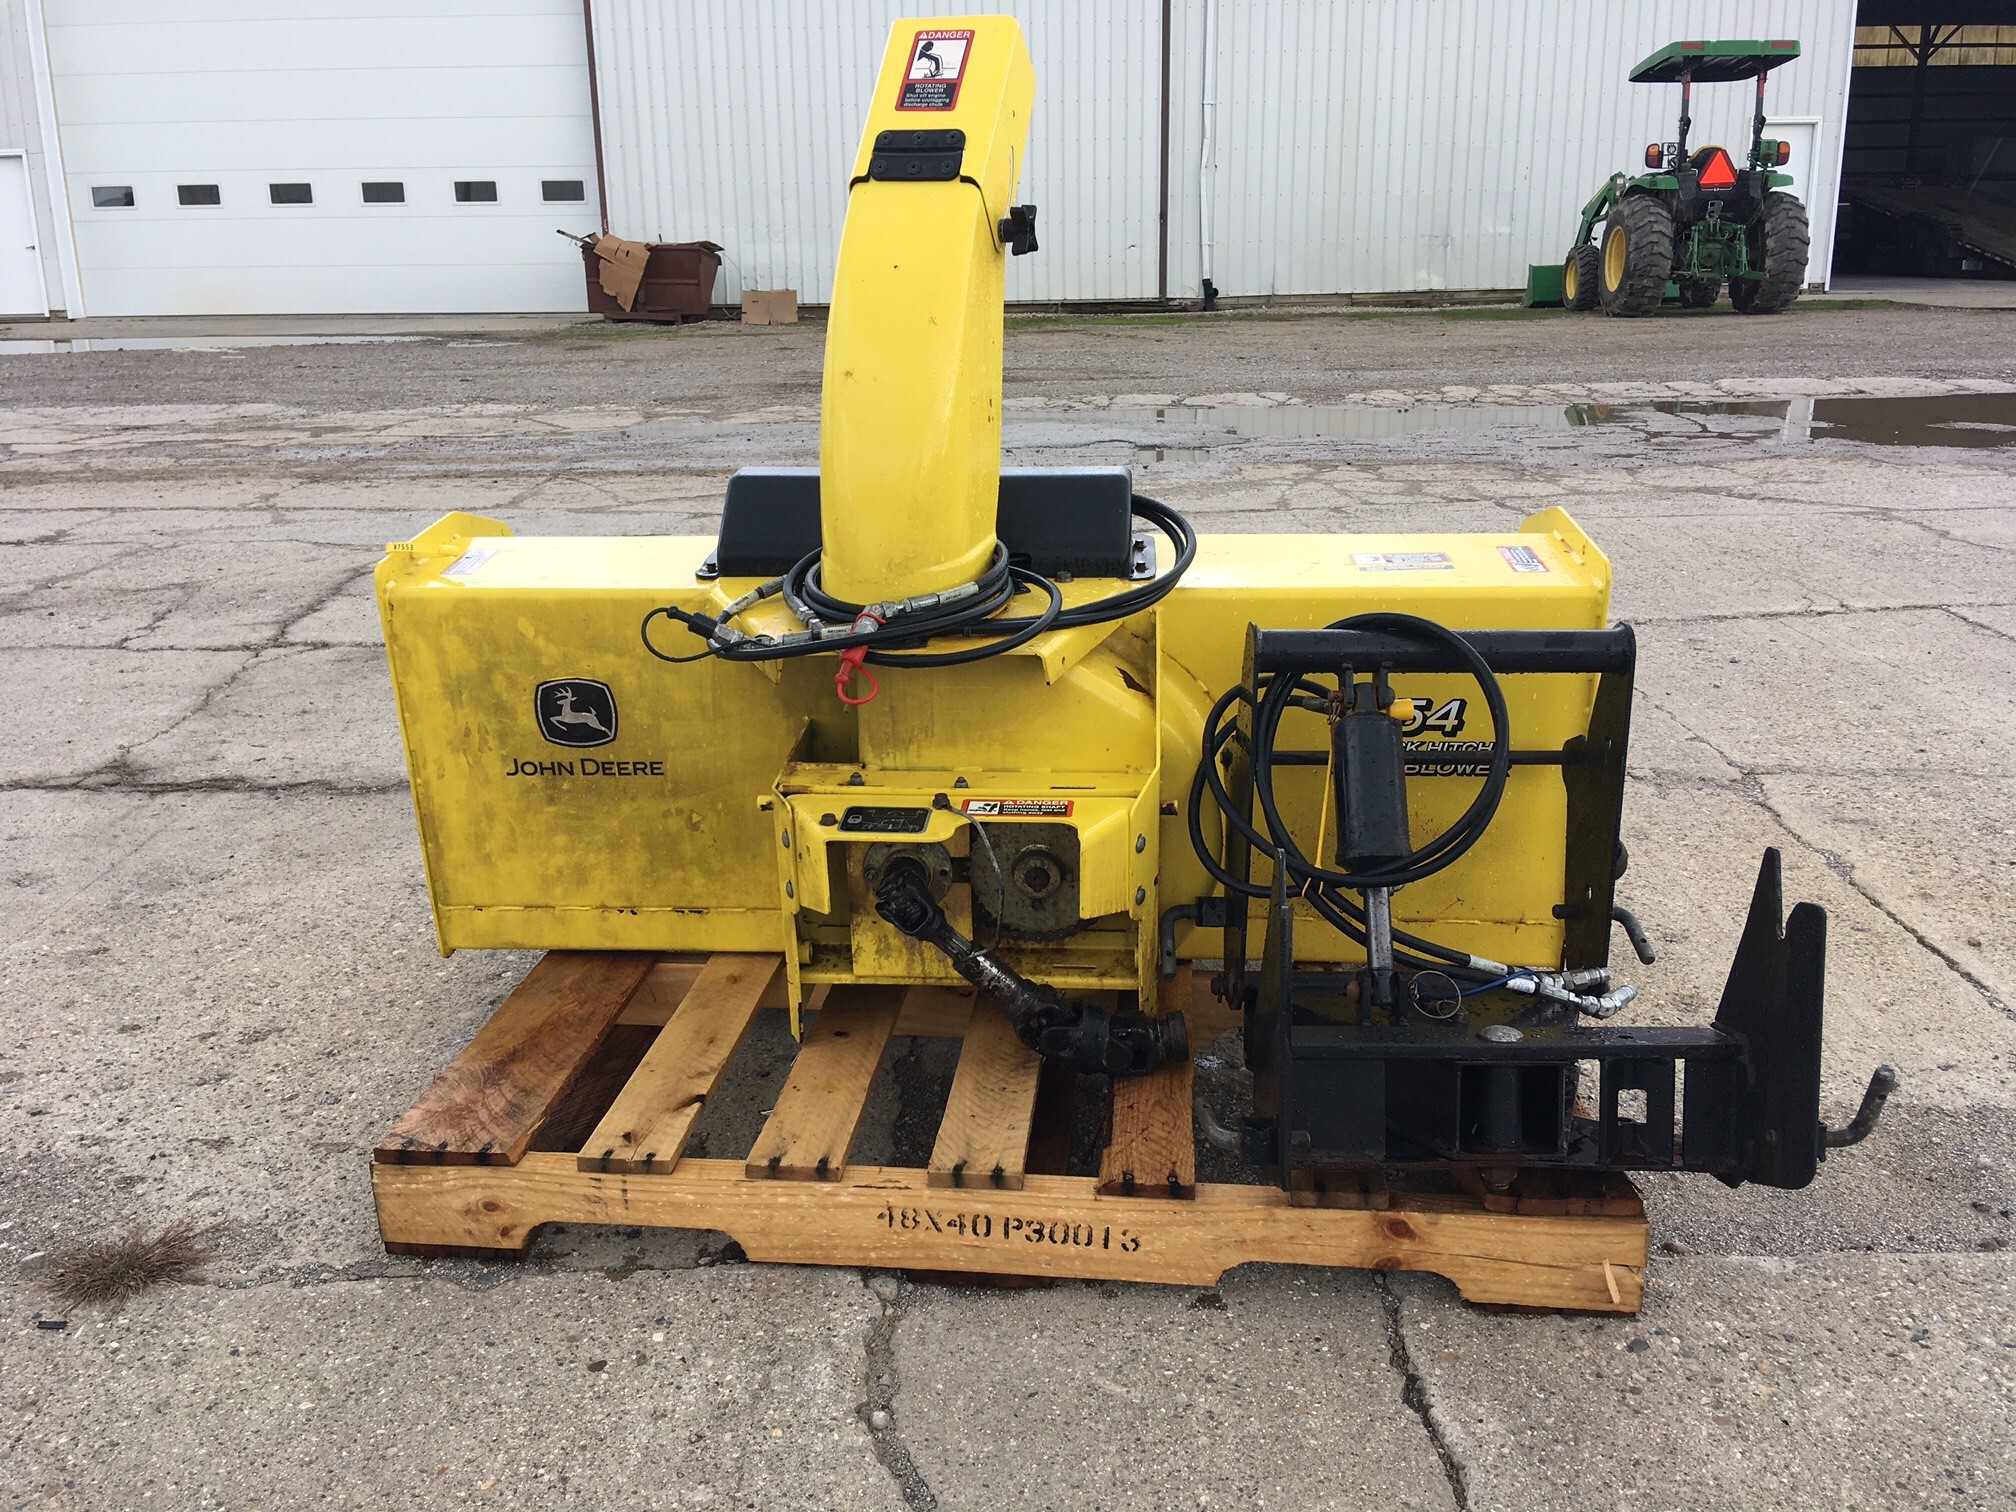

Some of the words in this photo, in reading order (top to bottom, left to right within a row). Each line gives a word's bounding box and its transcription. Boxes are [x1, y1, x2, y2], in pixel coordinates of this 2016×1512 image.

[928, 31, 970, 39] DANGER
[1427, 741, 1497, 753] HITCH
[506, 758, 574, 776] JOHN
[580, 758, 665, 776] DEERE
[876, 1203, 992, 1237] 48X40
